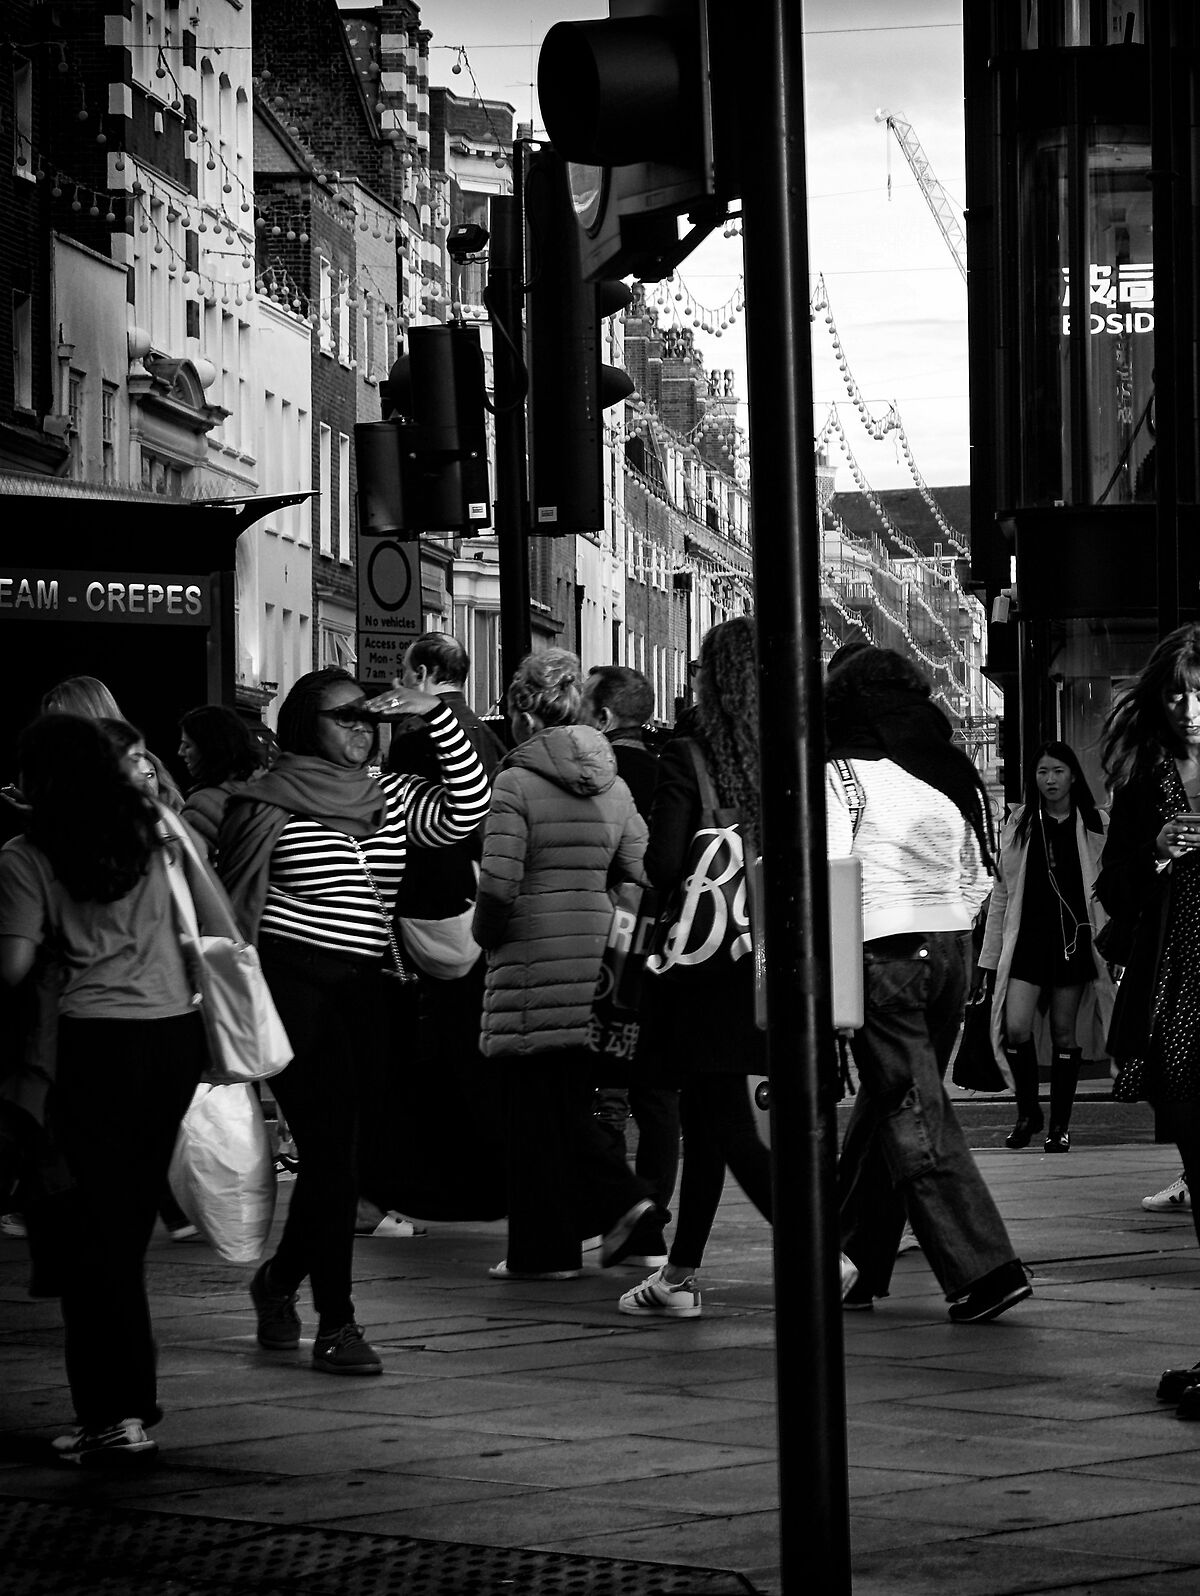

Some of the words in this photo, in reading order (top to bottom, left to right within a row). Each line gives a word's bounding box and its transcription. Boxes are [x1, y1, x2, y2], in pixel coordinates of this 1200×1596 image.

[86, 581, 202, 616] CREPES
[365, 615, 379, 626] No
[381, 616, 416, 629] vehicles
[365, 637, 396, 650] Access
[369, 652, 388, 664] Mon
[396, 653, 405, 665] S
